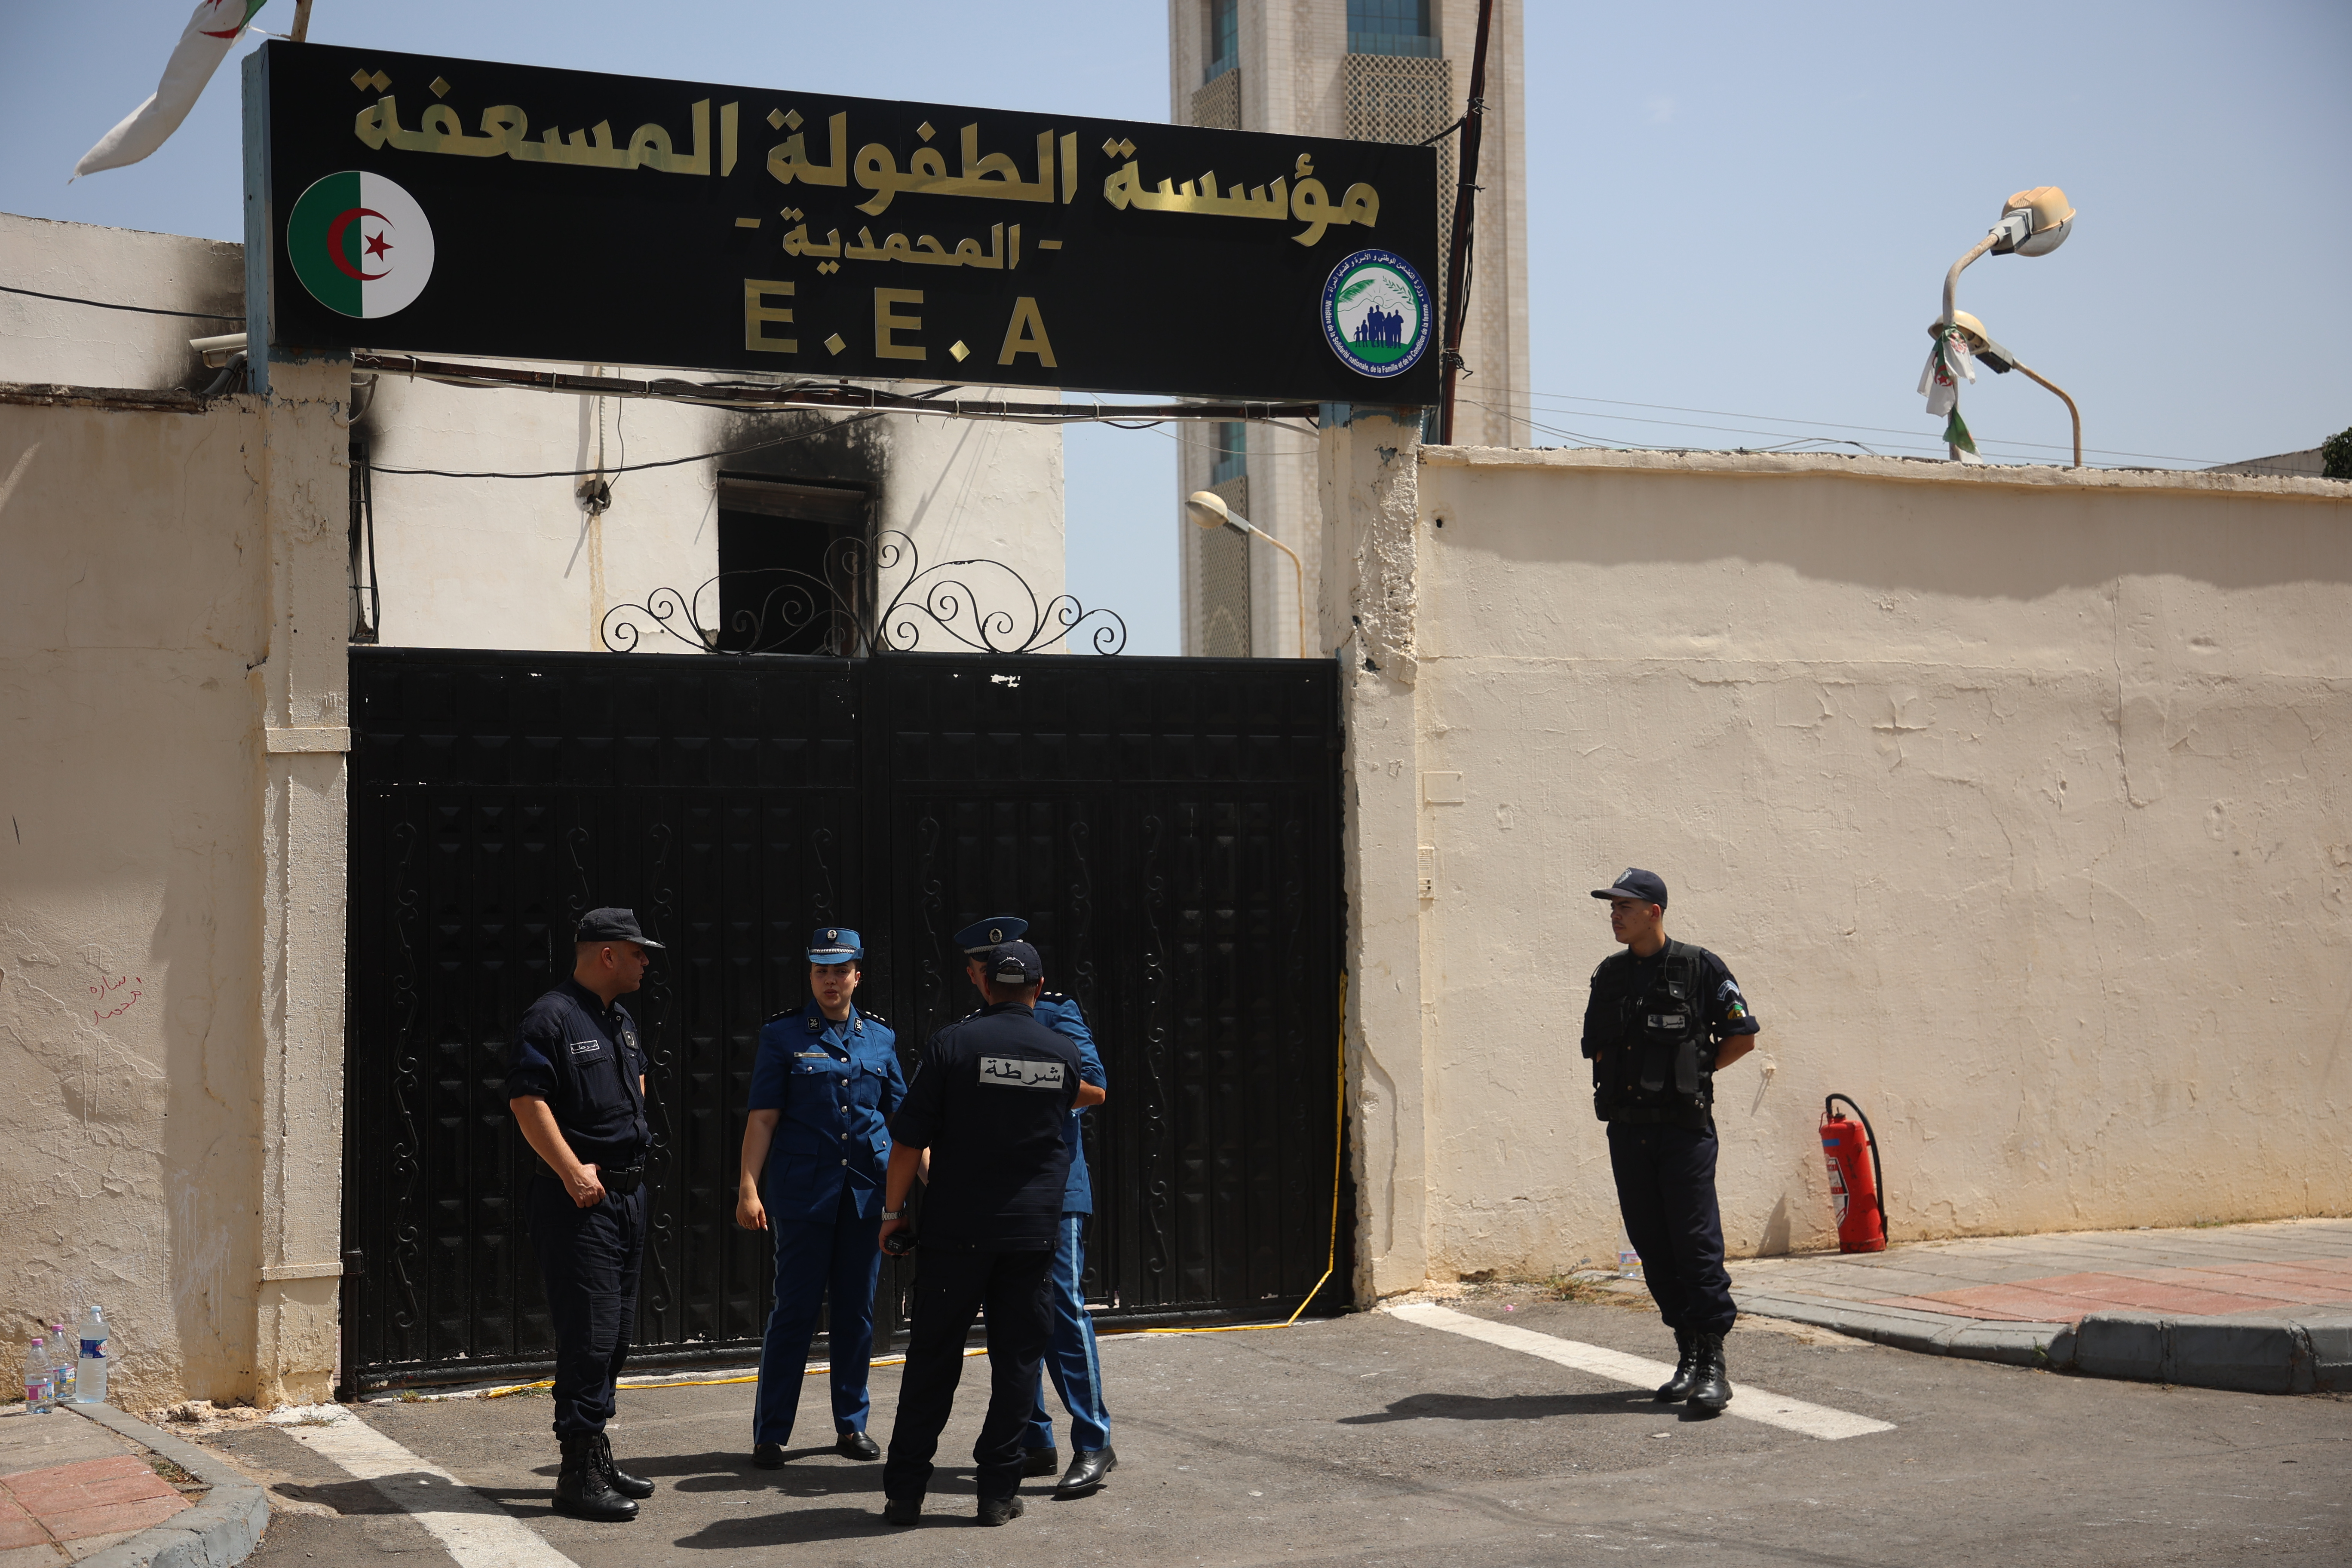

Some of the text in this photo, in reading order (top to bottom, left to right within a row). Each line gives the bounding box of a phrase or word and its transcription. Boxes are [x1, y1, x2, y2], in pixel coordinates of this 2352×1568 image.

[351, 68, 1380, 247] مؤسسة الطفولة المسعفة
[781, 206, 1020, 275] المحمدية
[1354, 253, 1371, 263] الأسرة
[1378, 254, 1396, 264] الوطني
[1336, 262, 1349, 277] قضايا
[1396, 263, 1416, 280] التضامن
[1328, 276, 1339, 293] المرأة
[1414, 280, 1423, 297] وزارة
[1333, 337, 1350, 359] Solidarité
[1348, 356, 1369, 373] nationale,
[1382, 364, 1398, 373] Famille
[1410, 335, 1426, 357] Condition
[984, 1060, 1061, 1085] شرطة
